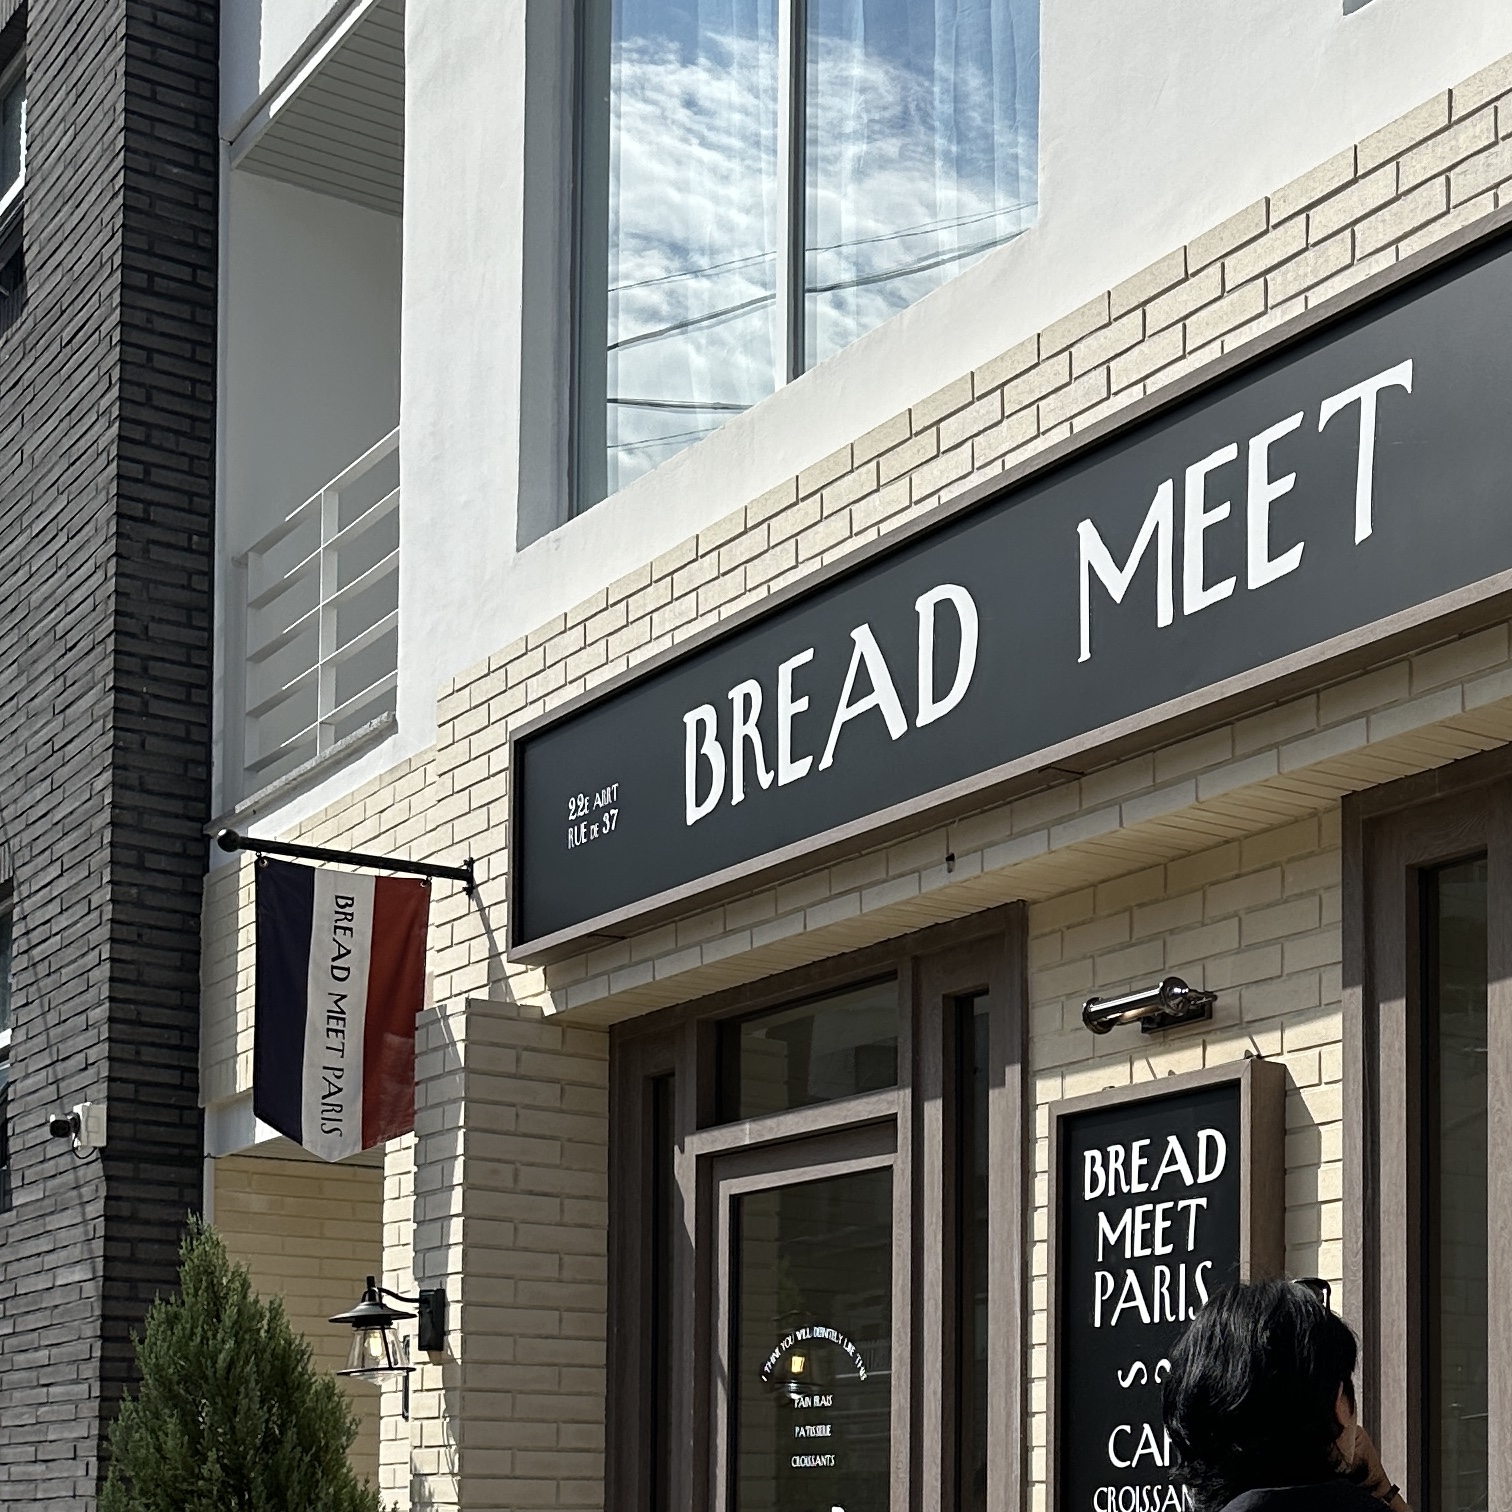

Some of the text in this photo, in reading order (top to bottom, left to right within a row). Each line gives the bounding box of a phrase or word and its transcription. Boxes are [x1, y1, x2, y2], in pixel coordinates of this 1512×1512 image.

[683, 584, 978, 825] BREAD
[1077, 359, 1412, 662] MEET
[568, 821, 587, 849] RUE
[602, 808, 619, 834] 37
[320, 895, 355, 1138] BREAD MEET PARIS
[1084, 1129, 1226, 1200] BREAD
[1098, 1198, 1207, 1261] MEET
[1095, 1261, 1212, 1327] PARIS
[781, 1333, 795, 1351] YOU
